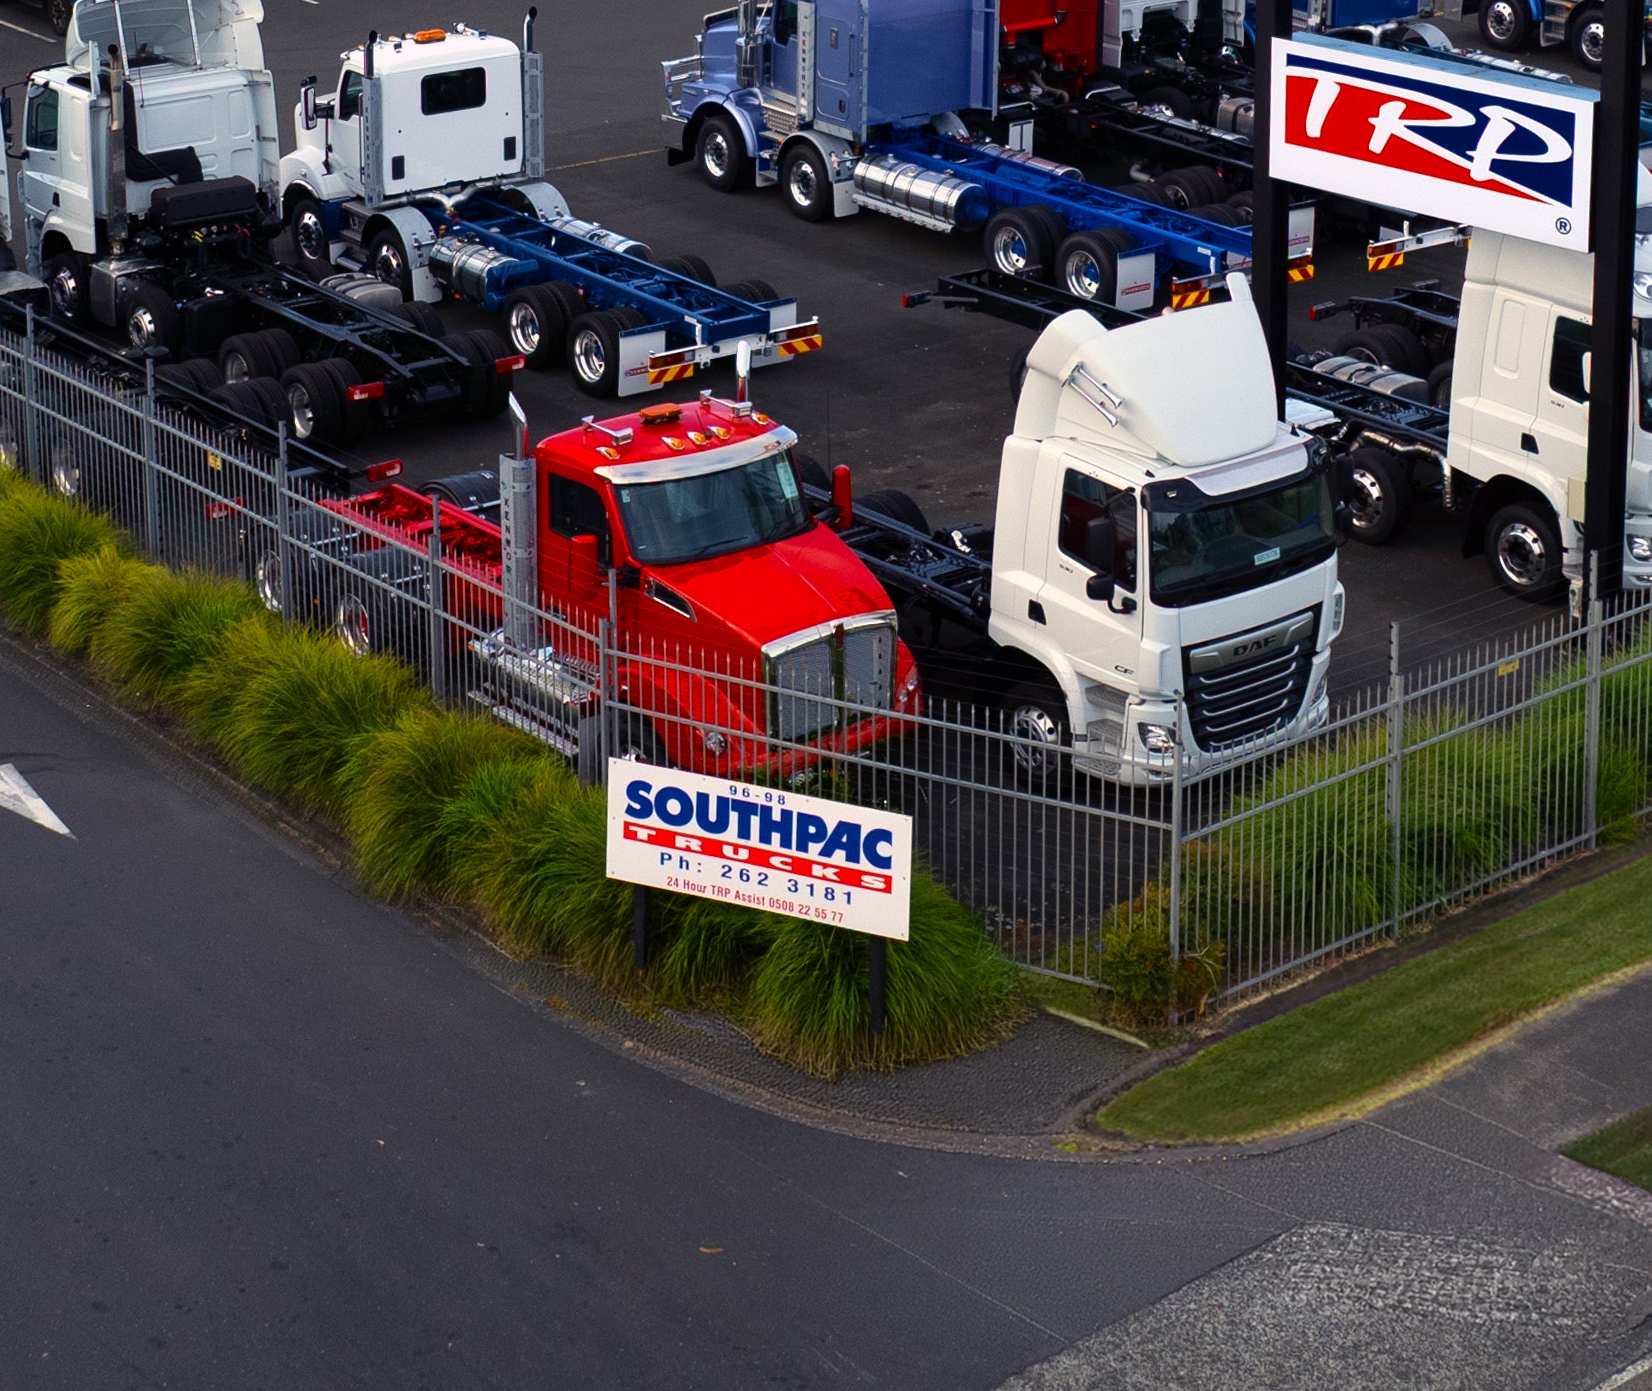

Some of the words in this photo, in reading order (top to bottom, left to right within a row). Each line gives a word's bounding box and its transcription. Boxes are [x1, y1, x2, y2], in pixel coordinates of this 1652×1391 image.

[1291, 72, 1573, 182] TRP
[1114, 664, 1135, 675] CF
[1233, 634, 1277, 658] DAF
[729, 784, 786, 806] 96-98
[624, 780, 893, 870] SOUTHPAC
[629, 825, 887, 889] TRUCKS
[660, 852, 702, 874] Ph:
[721, 864, 769, 887] 262
[787, 878, 853, 905] 3181
[667, 876, 681, 888] 24
[683, 880, 707, 894] Hour
[711, 883, 731, 898] TRP
[735, 888, 765, 906] Assist
[769, 895, 794, 912] 0508
[798, 903, 811, 916] 22
[814, 906, 827, 919] 55
[831, 910, 844, 924] 77
